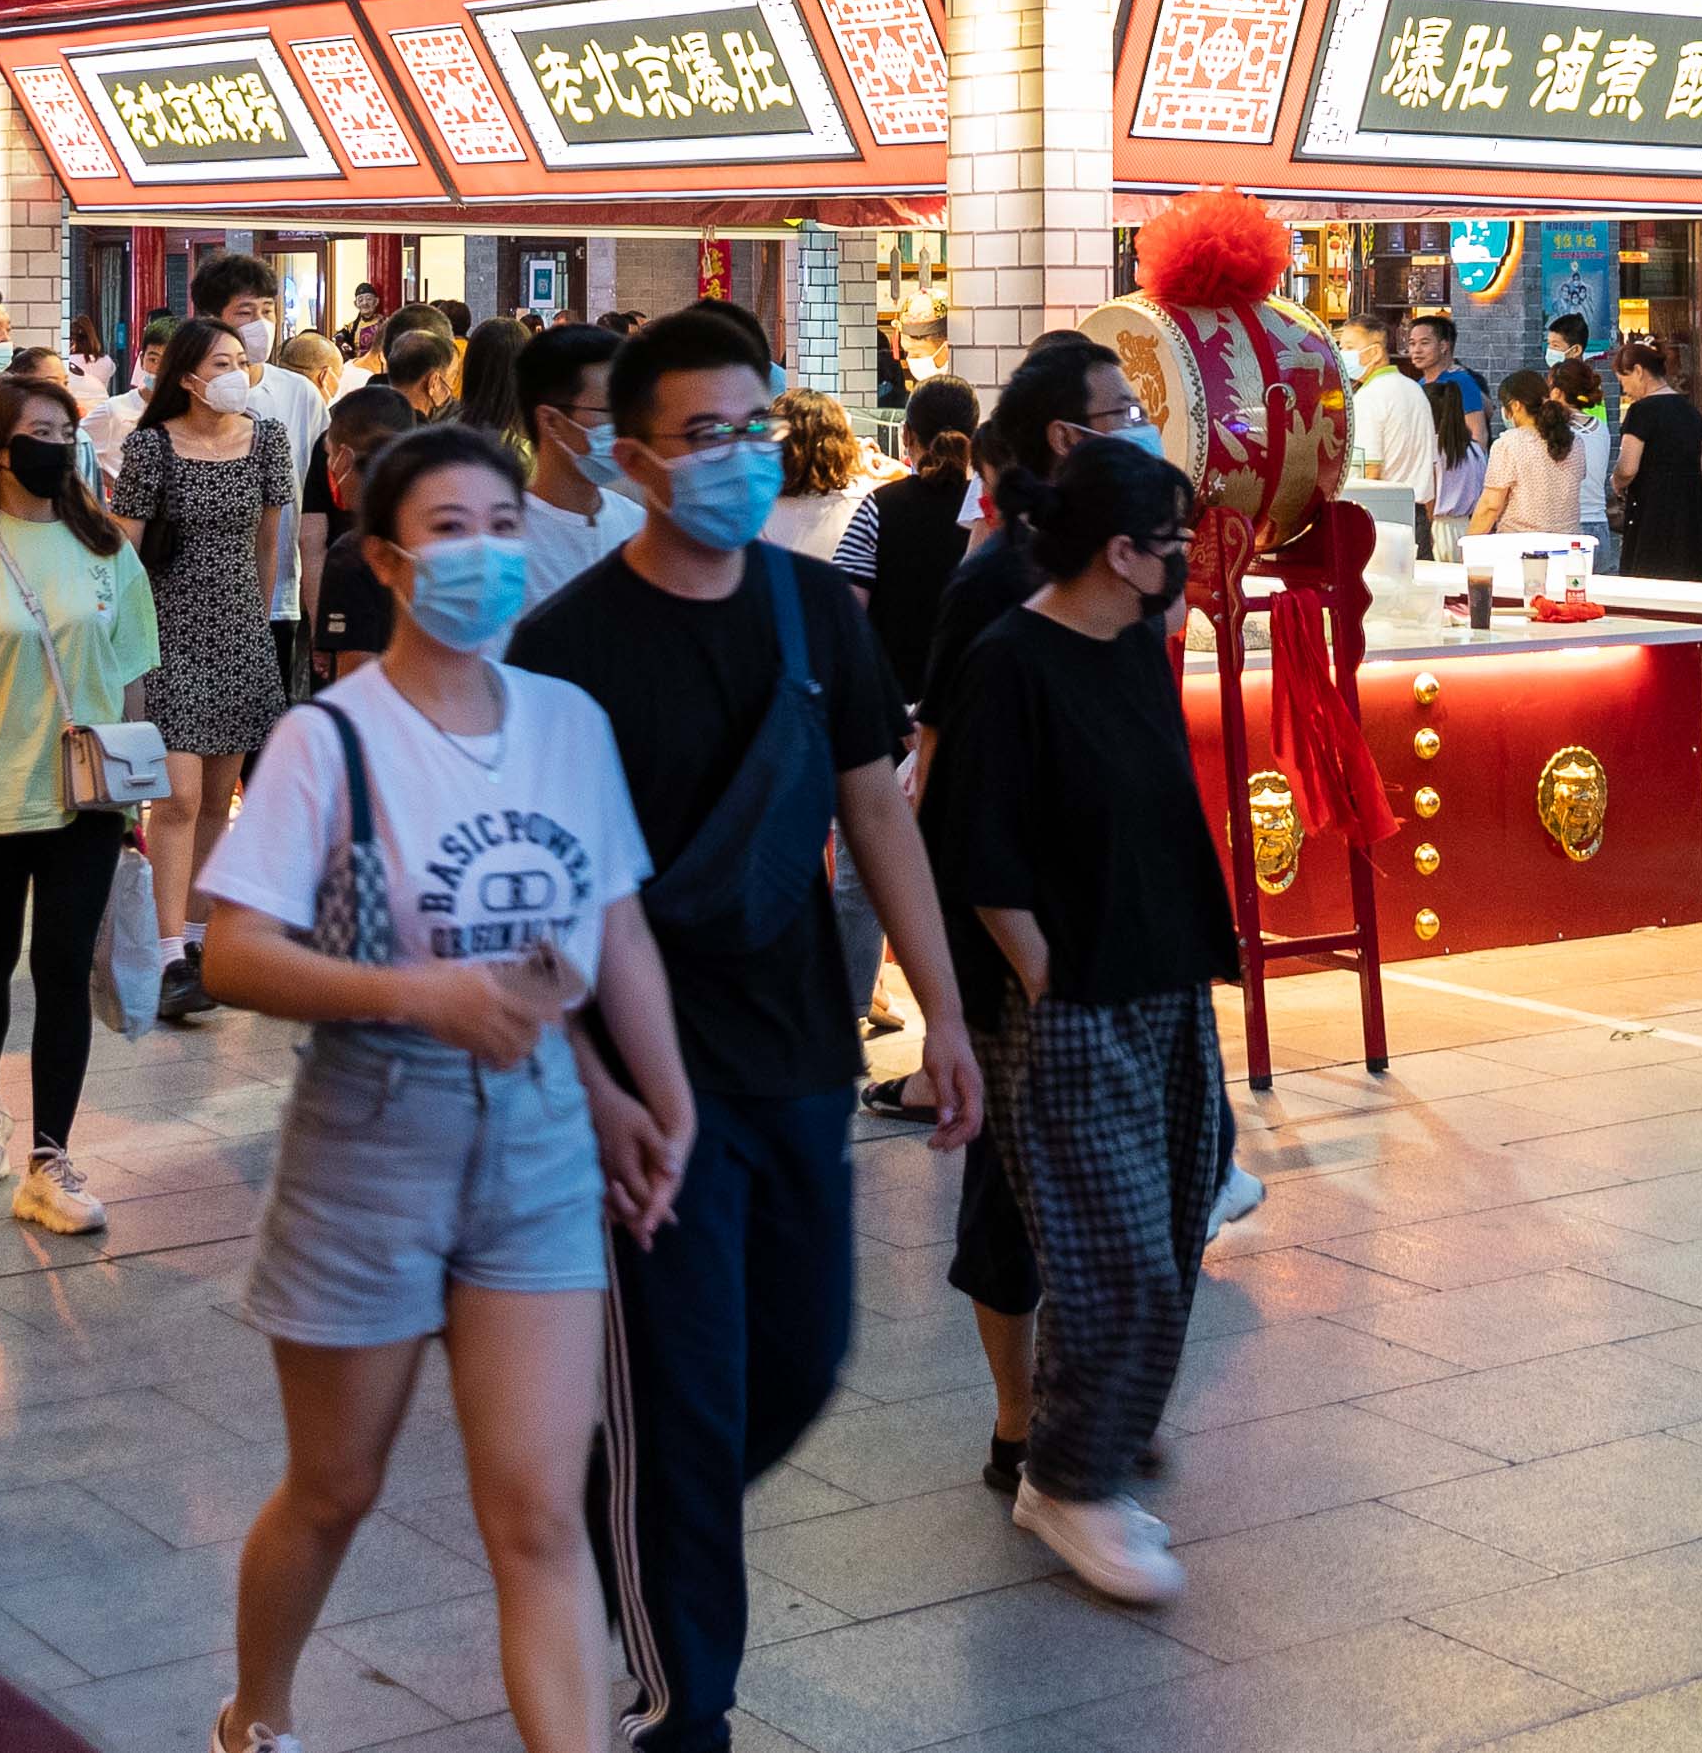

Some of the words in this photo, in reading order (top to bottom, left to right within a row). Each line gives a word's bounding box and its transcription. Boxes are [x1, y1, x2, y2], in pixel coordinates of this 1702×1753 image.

[534, 30, 793, 124] 老北京爆肚
